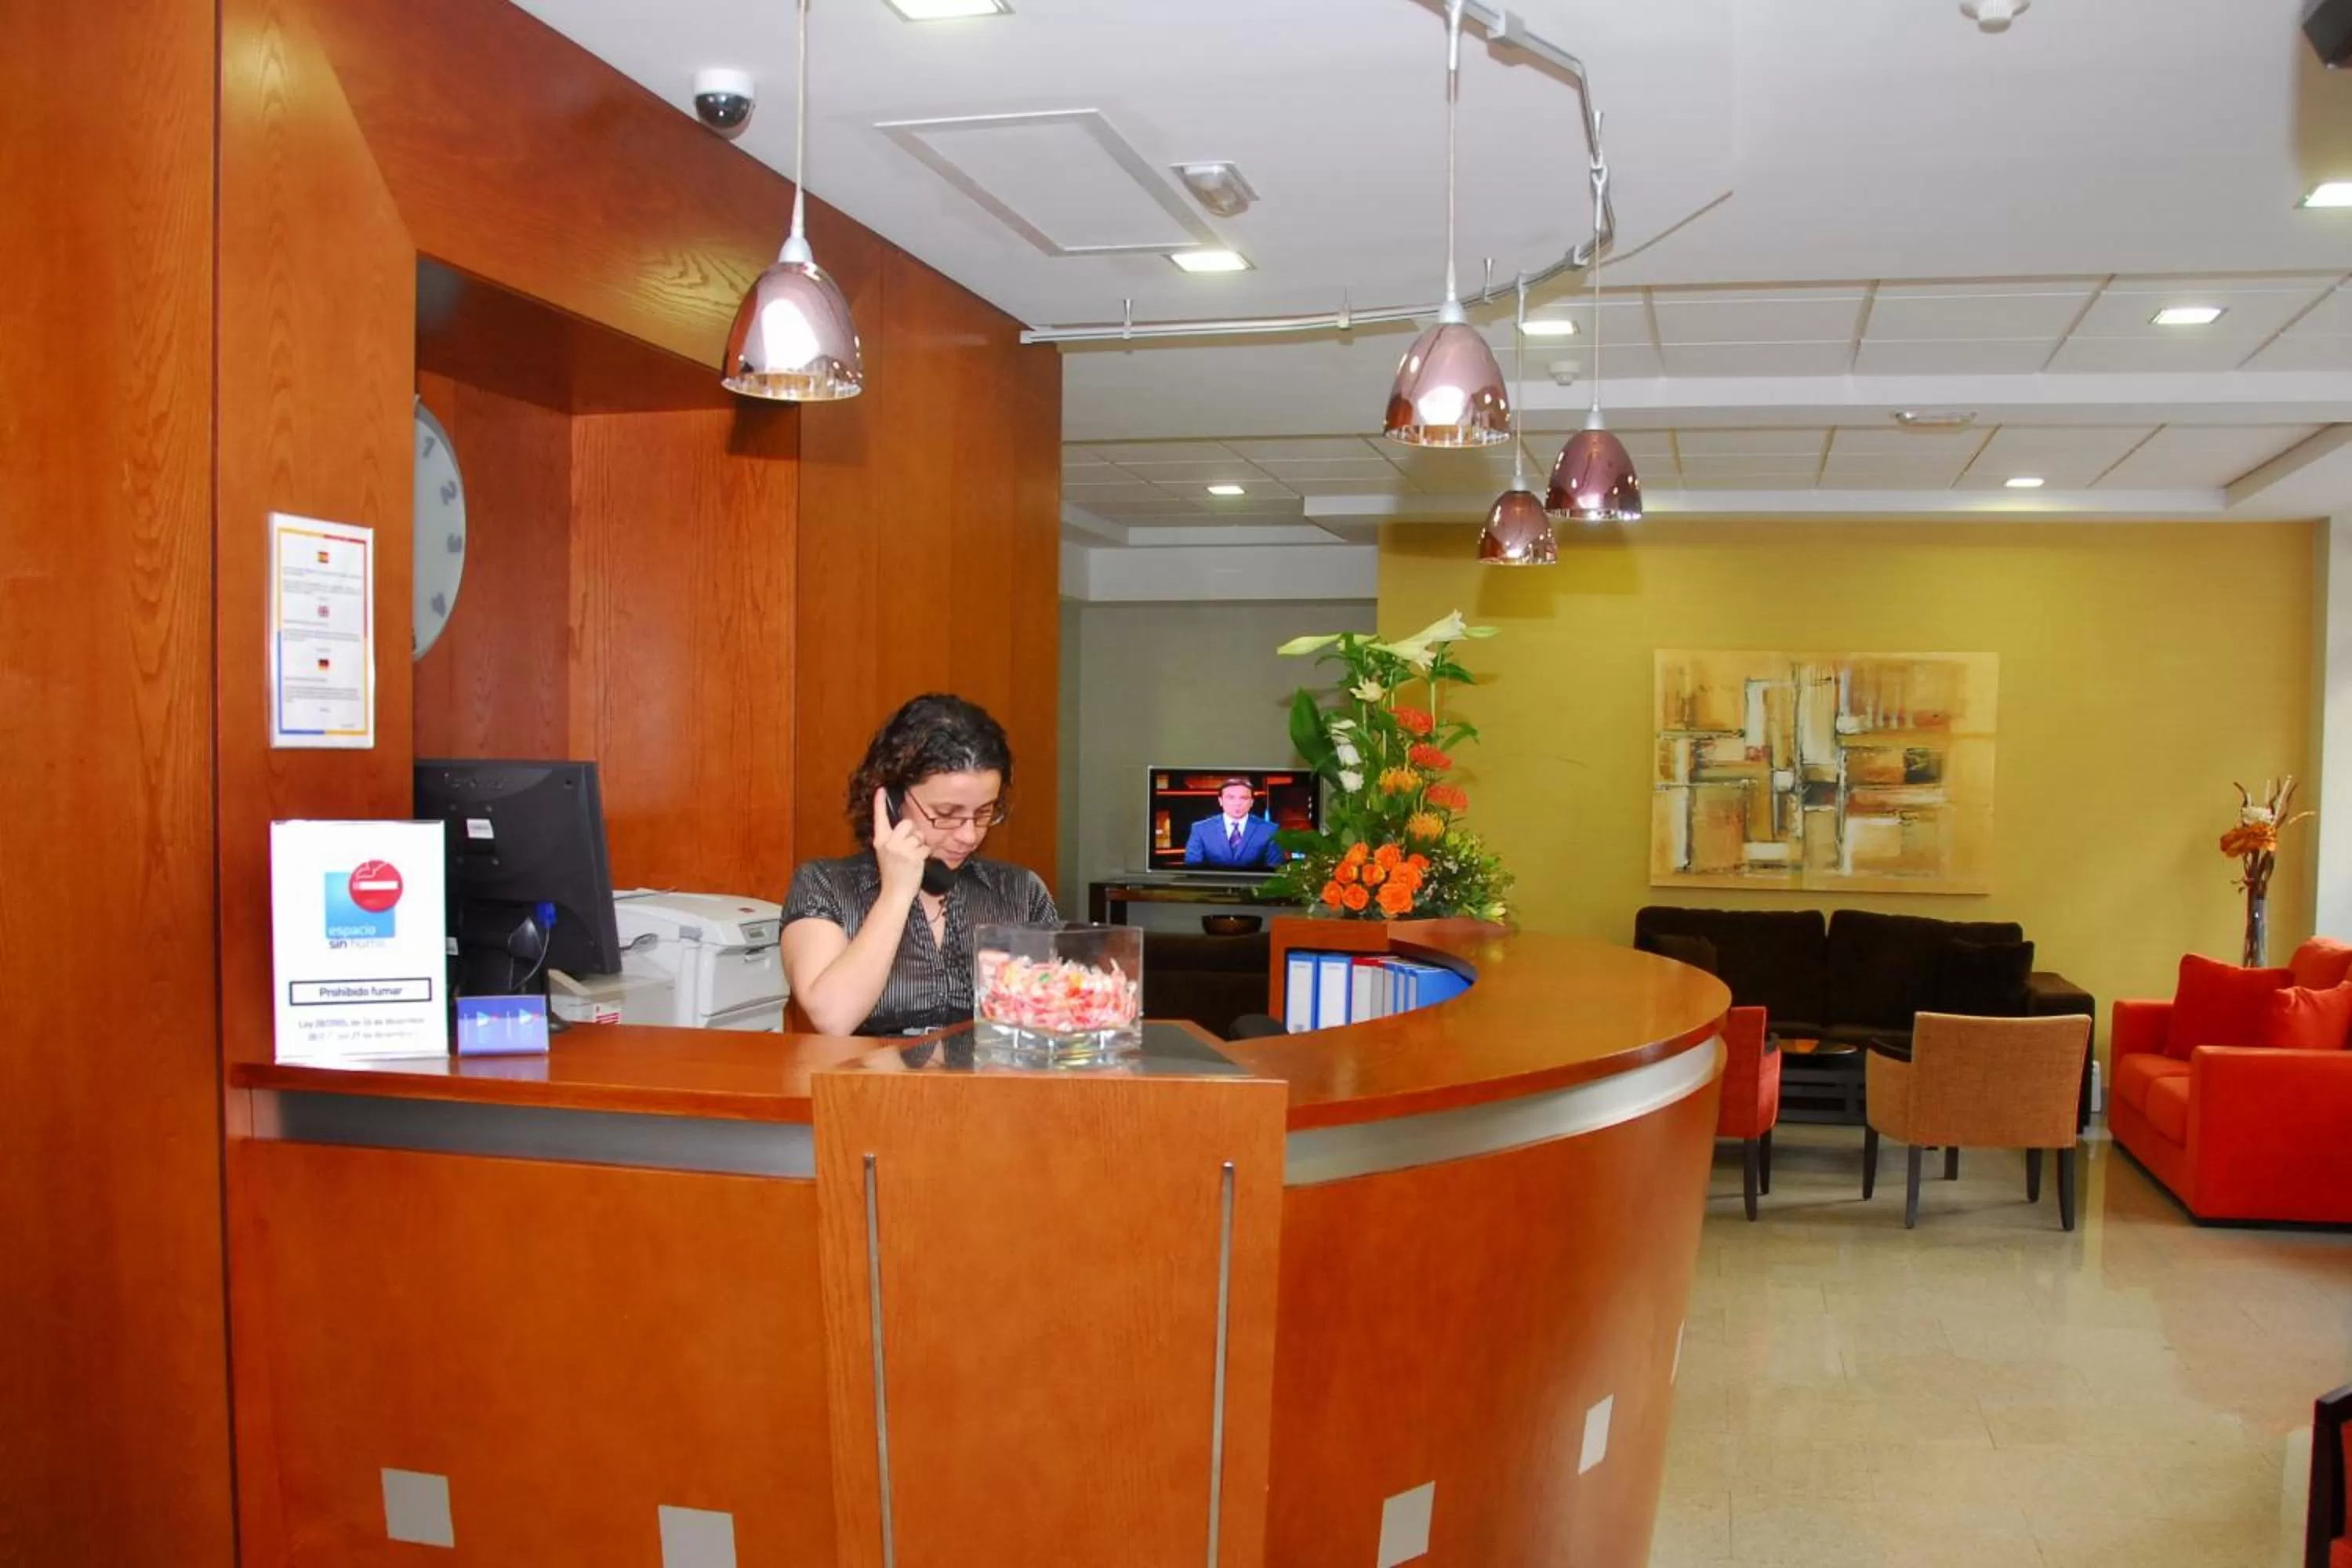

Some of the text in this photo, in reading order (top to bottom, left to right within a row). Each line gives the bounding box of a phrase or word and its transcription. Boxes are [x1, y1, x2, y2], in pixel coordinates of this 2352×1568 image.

[440, 480, 457, 506] 2
[329, 938, 347, 949] sin
[319, 985, 402, 998] Prohibido fumar
